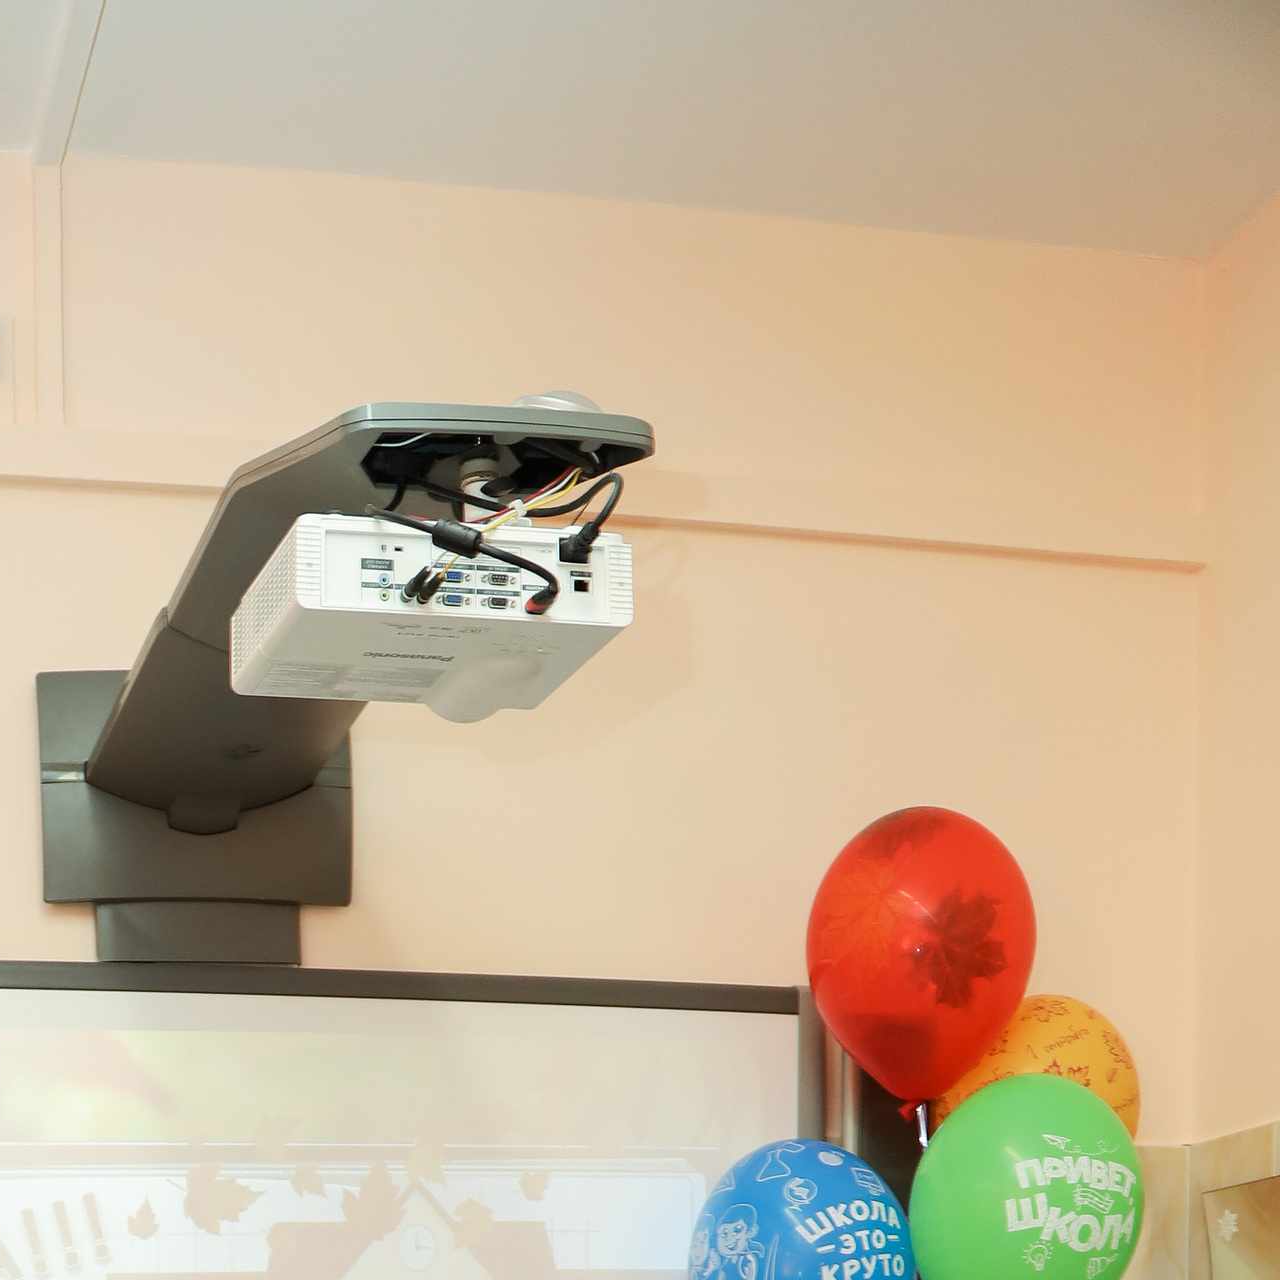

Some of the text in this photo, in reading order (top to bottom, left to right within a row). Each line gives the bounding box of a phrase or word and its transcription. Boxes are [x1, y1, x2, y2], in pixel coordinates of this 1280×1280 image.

[363, 651, 455, 662] Panasonic
[795, 1199, 902, 1244] ШКОЛА
[1004, 1192, 1136, 1253] ШКОЛА
